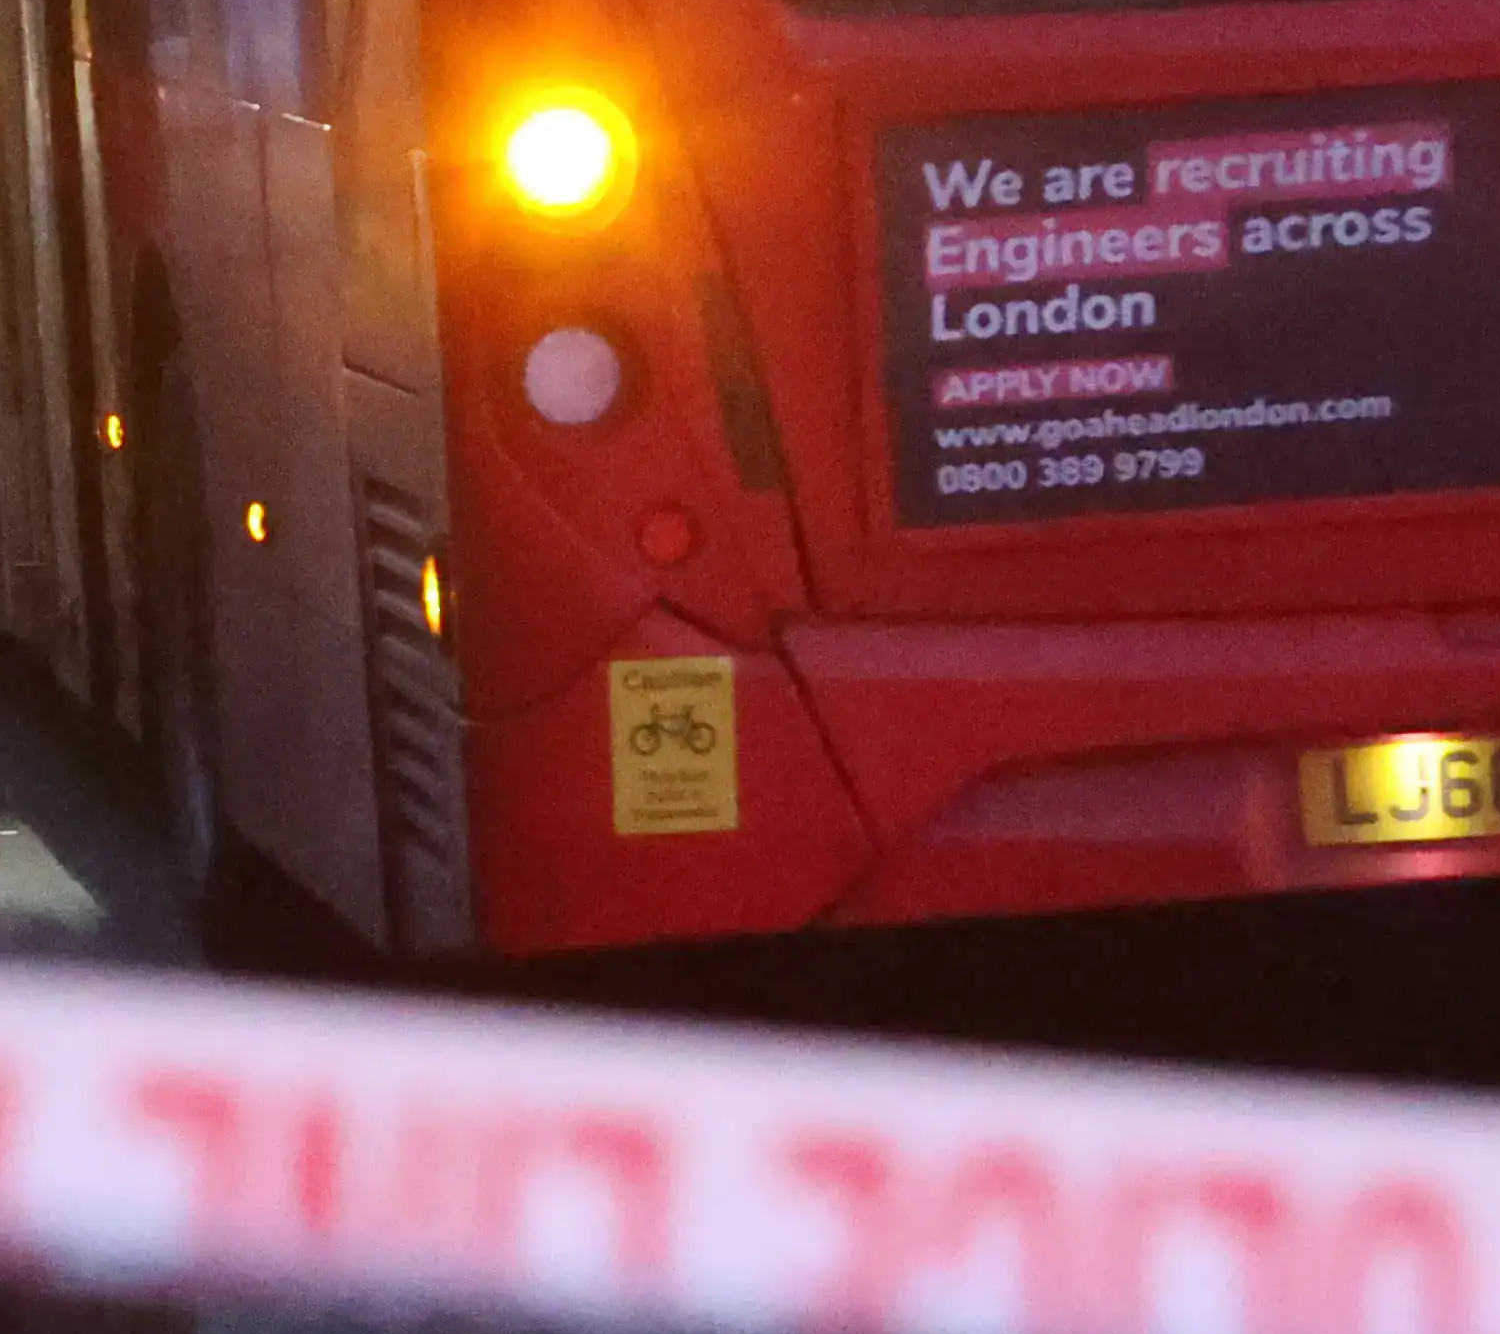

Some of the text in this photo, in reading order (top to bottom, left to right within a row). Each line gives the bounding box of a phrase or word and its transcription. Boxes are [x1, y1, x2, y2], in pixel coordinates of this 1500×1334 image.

[924, 130, 1446, 210] We are recruiting
[927, 206, 1432, 282] Engineers across
[931, 284, 1157, 341] London
[941, 361, 1169, 405] APPLY NOW
[935, 395, 1393, 450] www.goaheadlondon.com
[938, 461, 1027, 495] 0800
[1112, 447, 1203, 482] 9799
